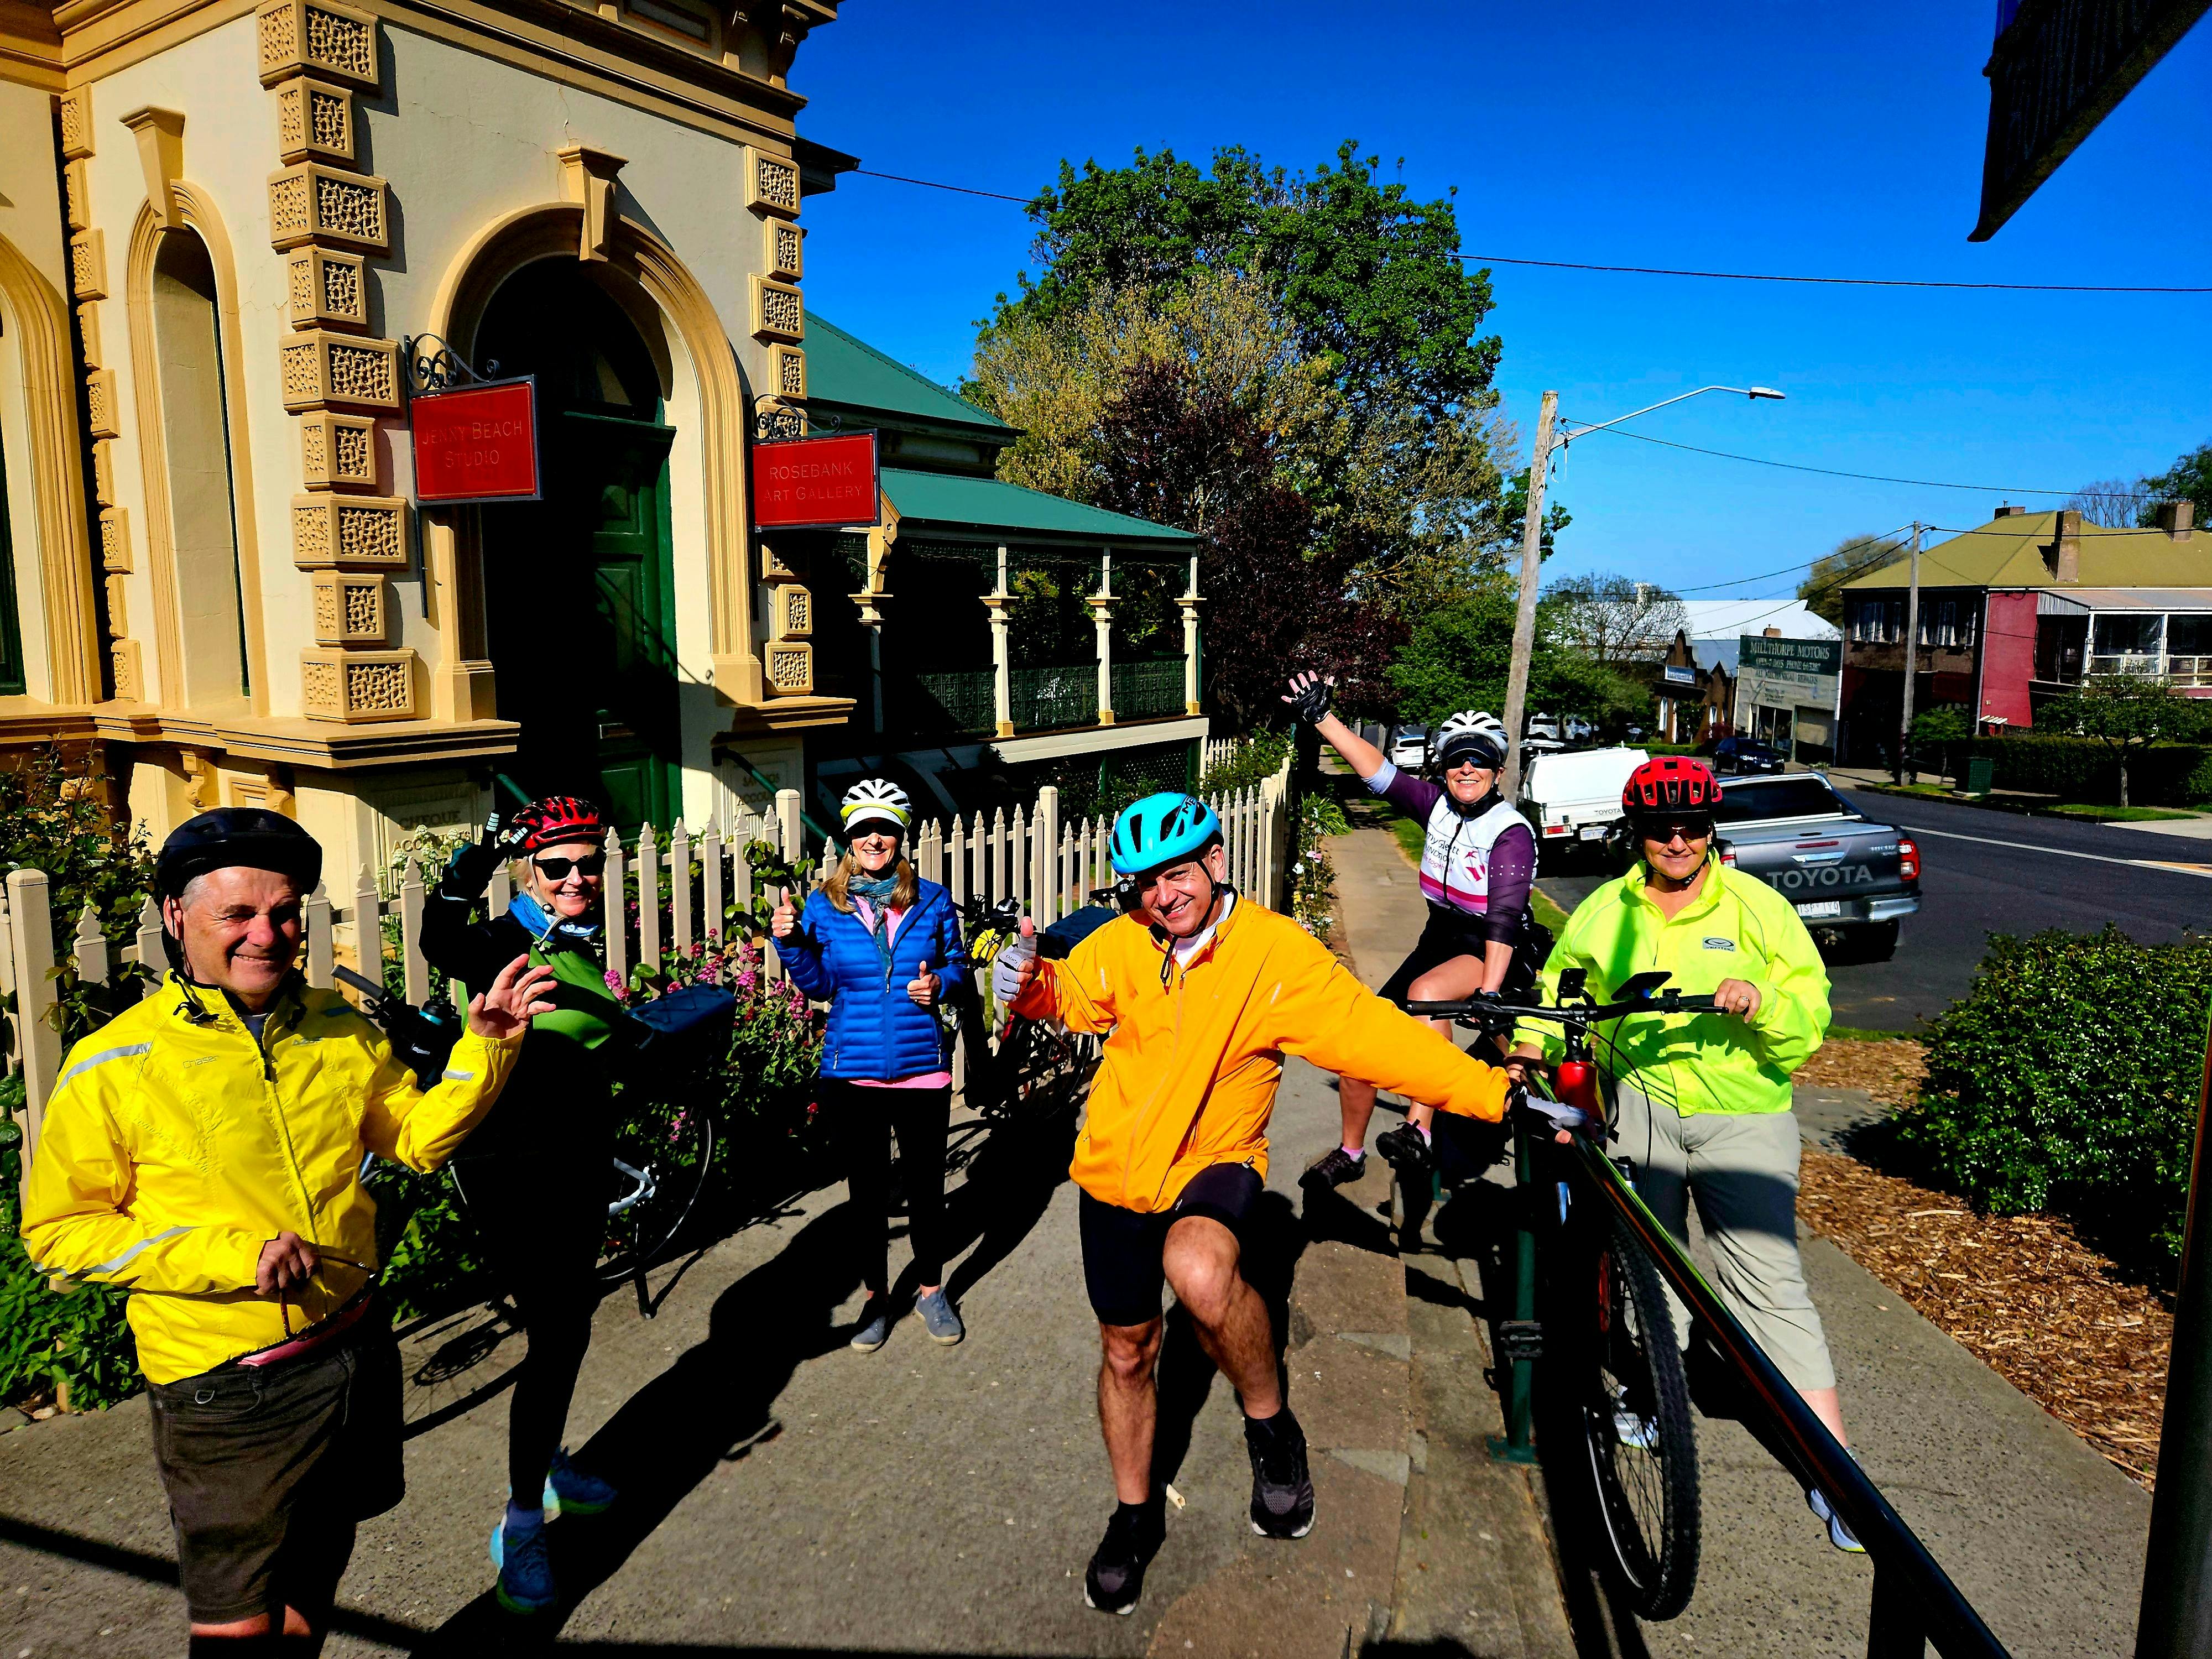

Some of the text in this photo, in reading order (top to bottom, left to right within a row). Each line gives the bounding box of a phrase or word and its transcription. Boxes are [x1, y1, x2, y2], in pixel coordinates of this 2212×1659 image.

[422, 420, 522, 444] JENNY BEACH
[445, 450, 499, 467] STUDIO
[770, 461, 852, 480] ROSEBANK
[761, 486, 862, 502] ART GALLERY
[1750, 641, 1830, 659] MILLTHORPE MOTORS
[1182, 797, 1196, 815] ME
[1766, 865, 1874, 889] TOYOTA
[183, 1056, 219, 1068] Chaser
